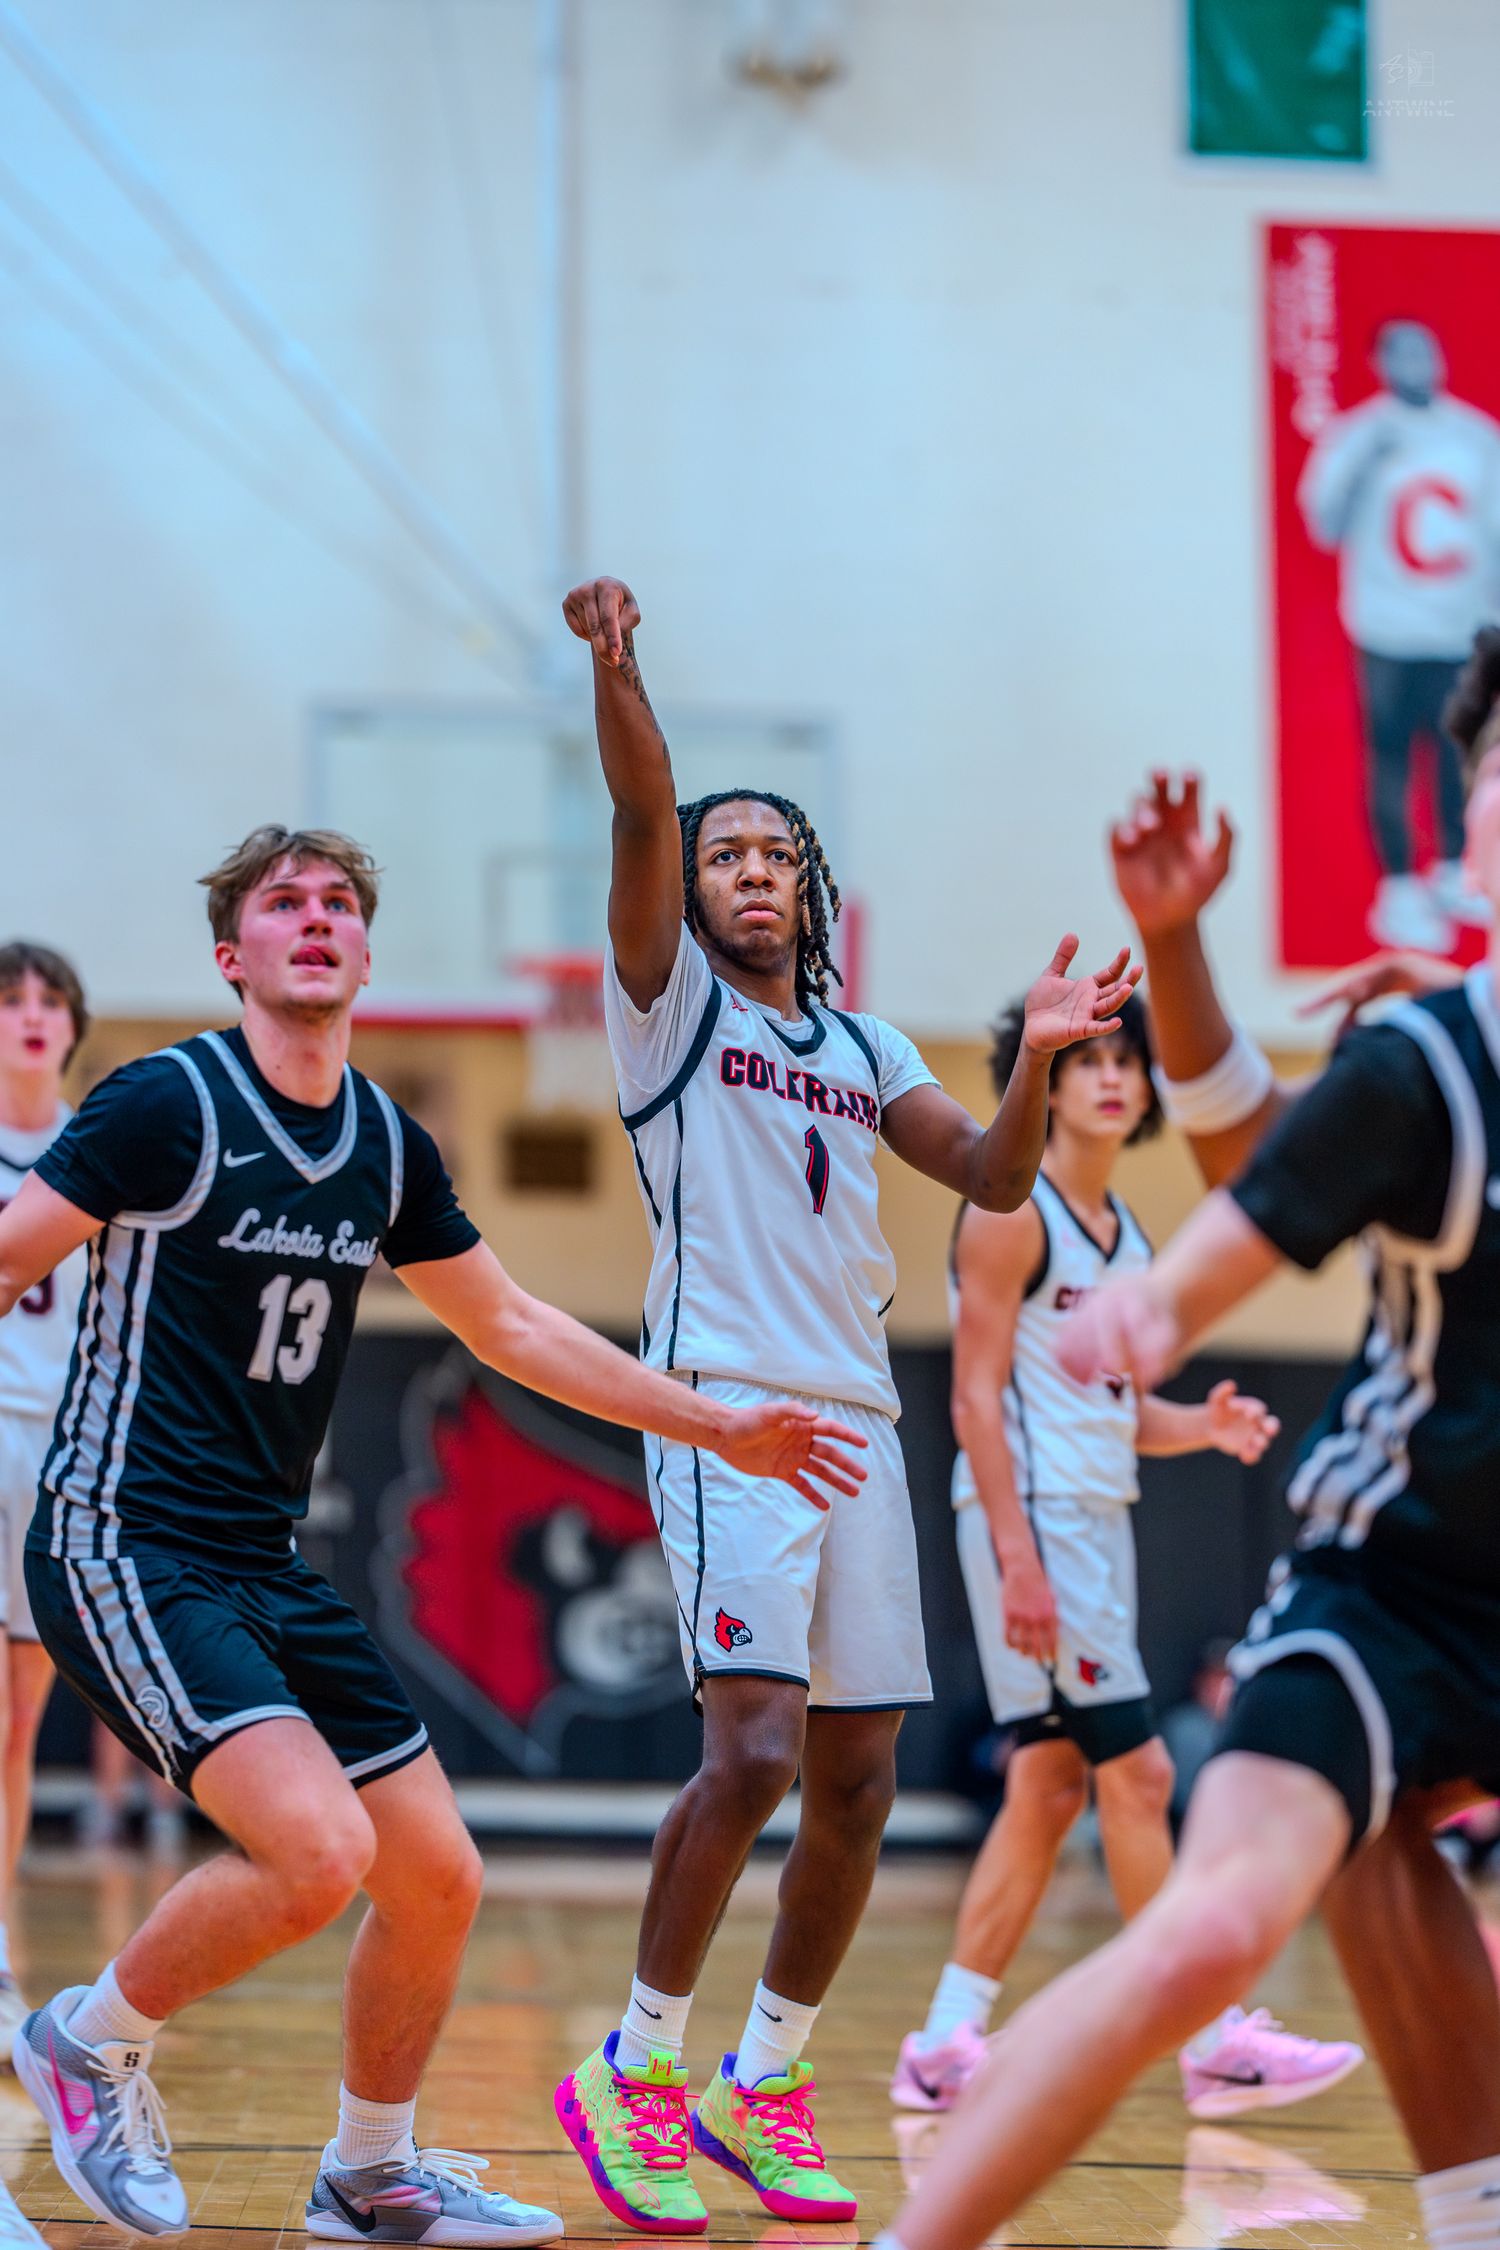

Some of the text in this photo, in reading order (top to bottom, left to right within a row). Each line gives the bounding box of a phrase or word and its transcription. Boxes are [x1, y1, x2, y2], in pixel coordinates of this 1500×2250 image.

[1390, 477, 1471, 576] C
[804, 1124, 829, 1216] 1
[217, 1207, 325, 1259] Lakota
[246, 1273, 332, 1385] 13
